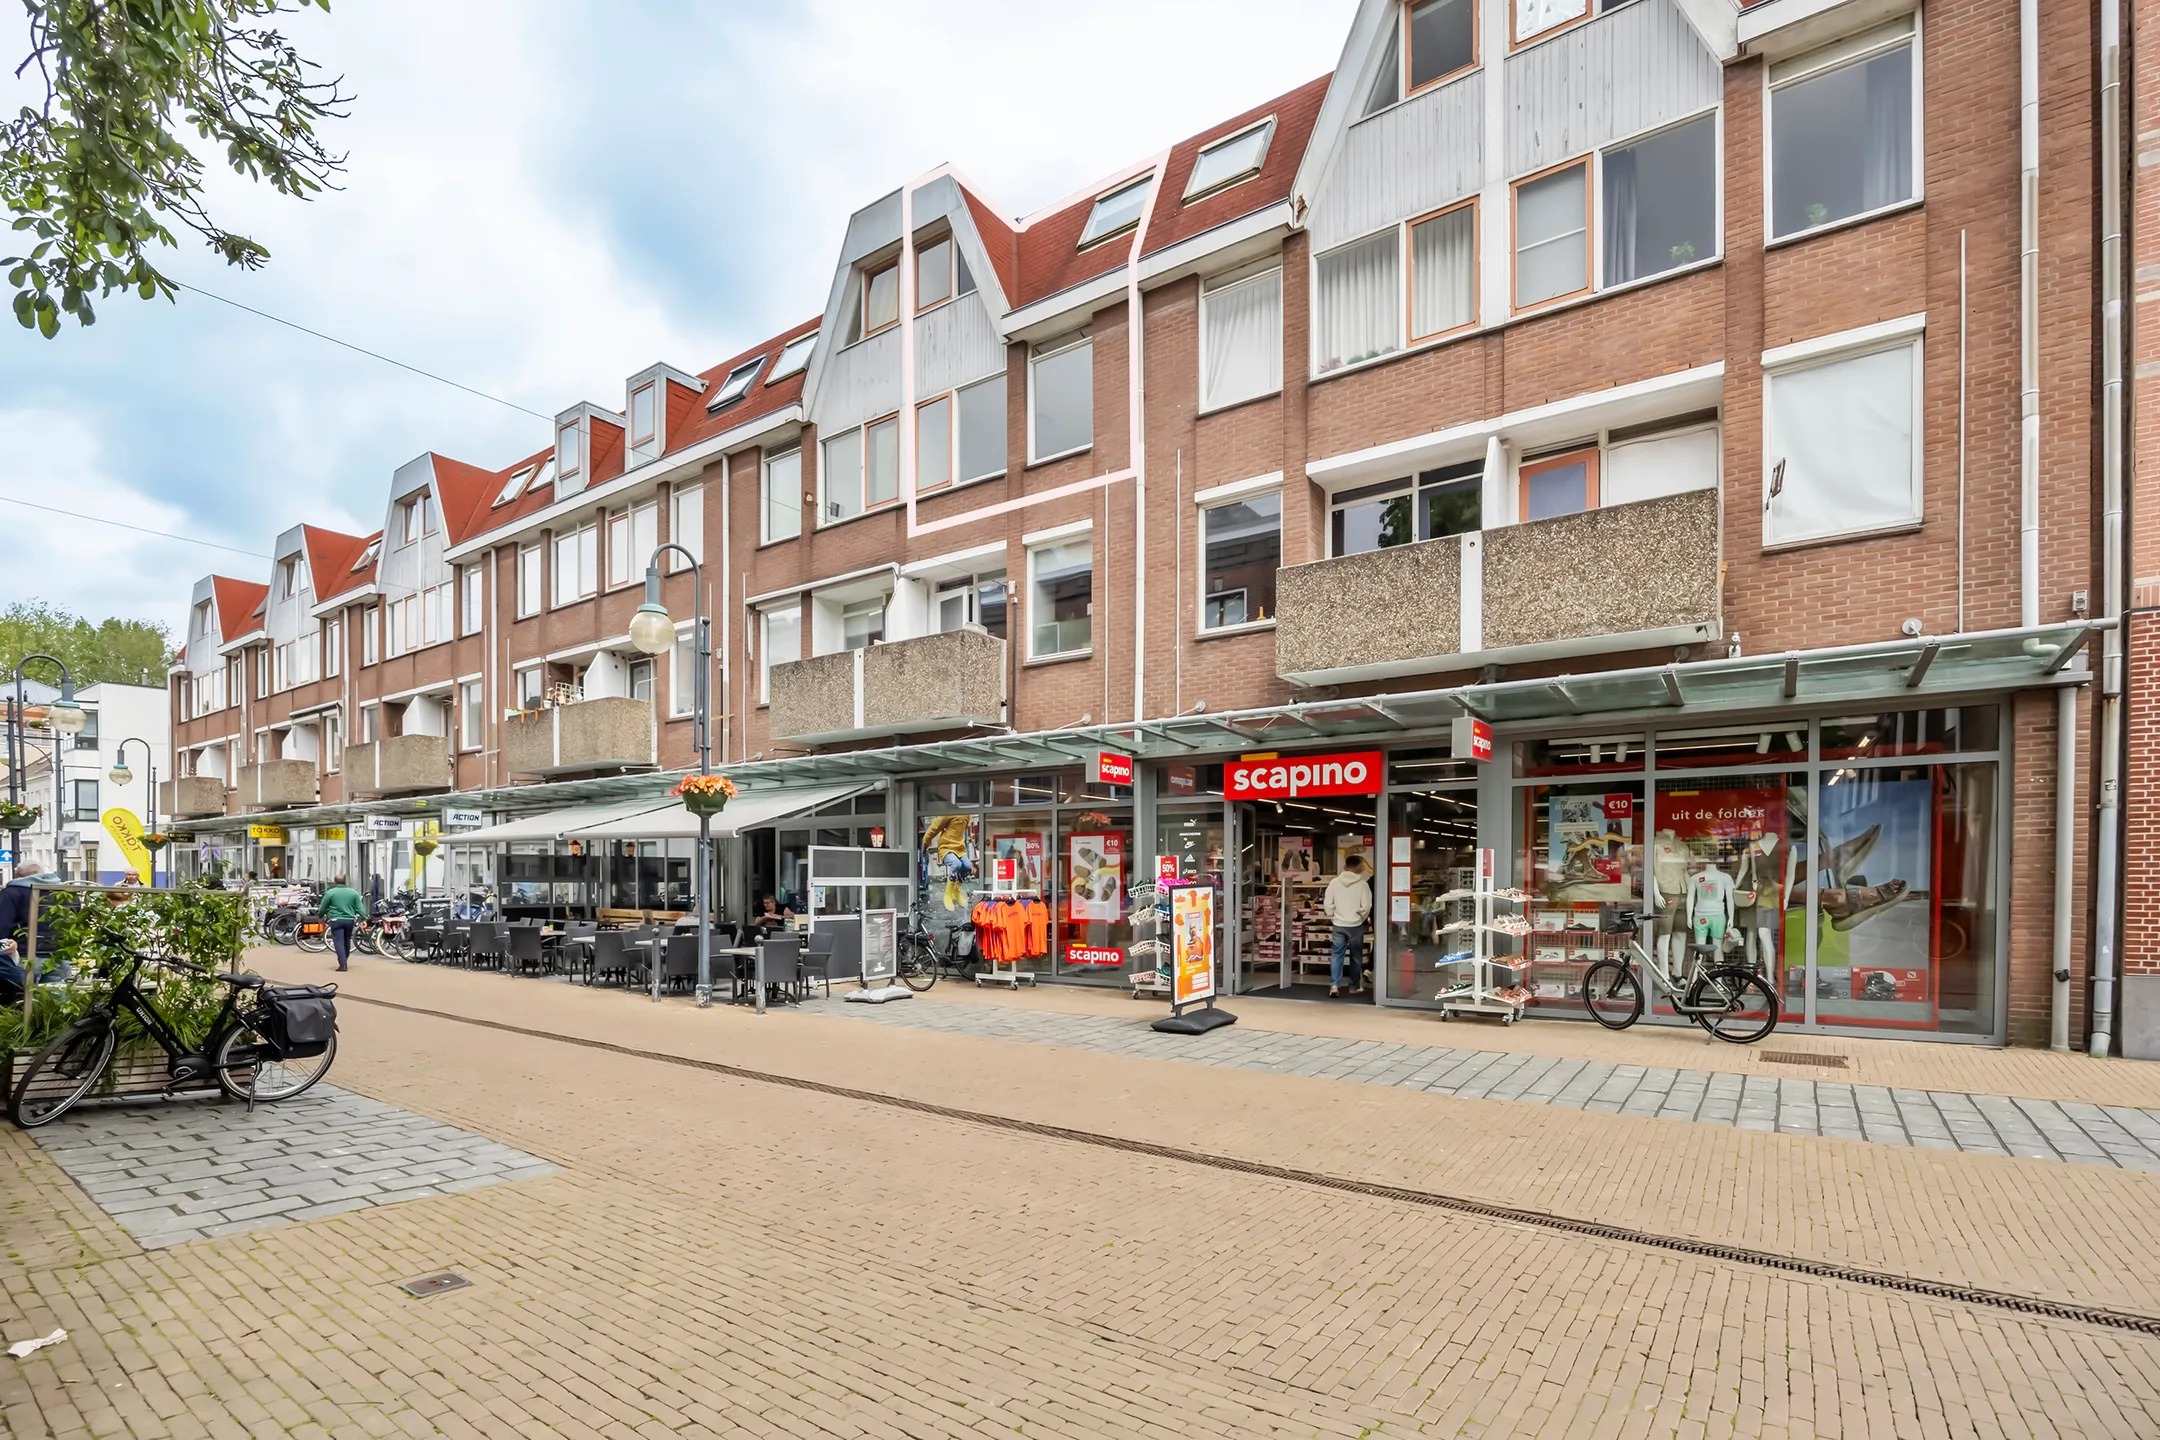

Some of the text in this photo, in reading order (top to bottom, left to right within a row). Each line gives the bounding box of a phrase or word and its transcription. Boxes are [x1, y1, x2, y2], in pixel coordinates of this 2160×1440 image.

[1474, 735, 1491, 752] scapino
[1101, 763, 1130, 778] scapino
[1234, 761, 1367, 797] scapino
[1608, 800, 1628, 809] €10
[453, 813, 480, 822] ACTION
[1672, 807, 1765, 820] uit de folder
[373, 819, 399, 827] ACTION
[1026, 842, 1040, 850] 50%
[1106, 839, 1119, 847] €10
[1162, 863, 1175, 873] 50%
[1069, 949, 1120, 965] scapino
[136, 1007, 152, 1025] UNION
